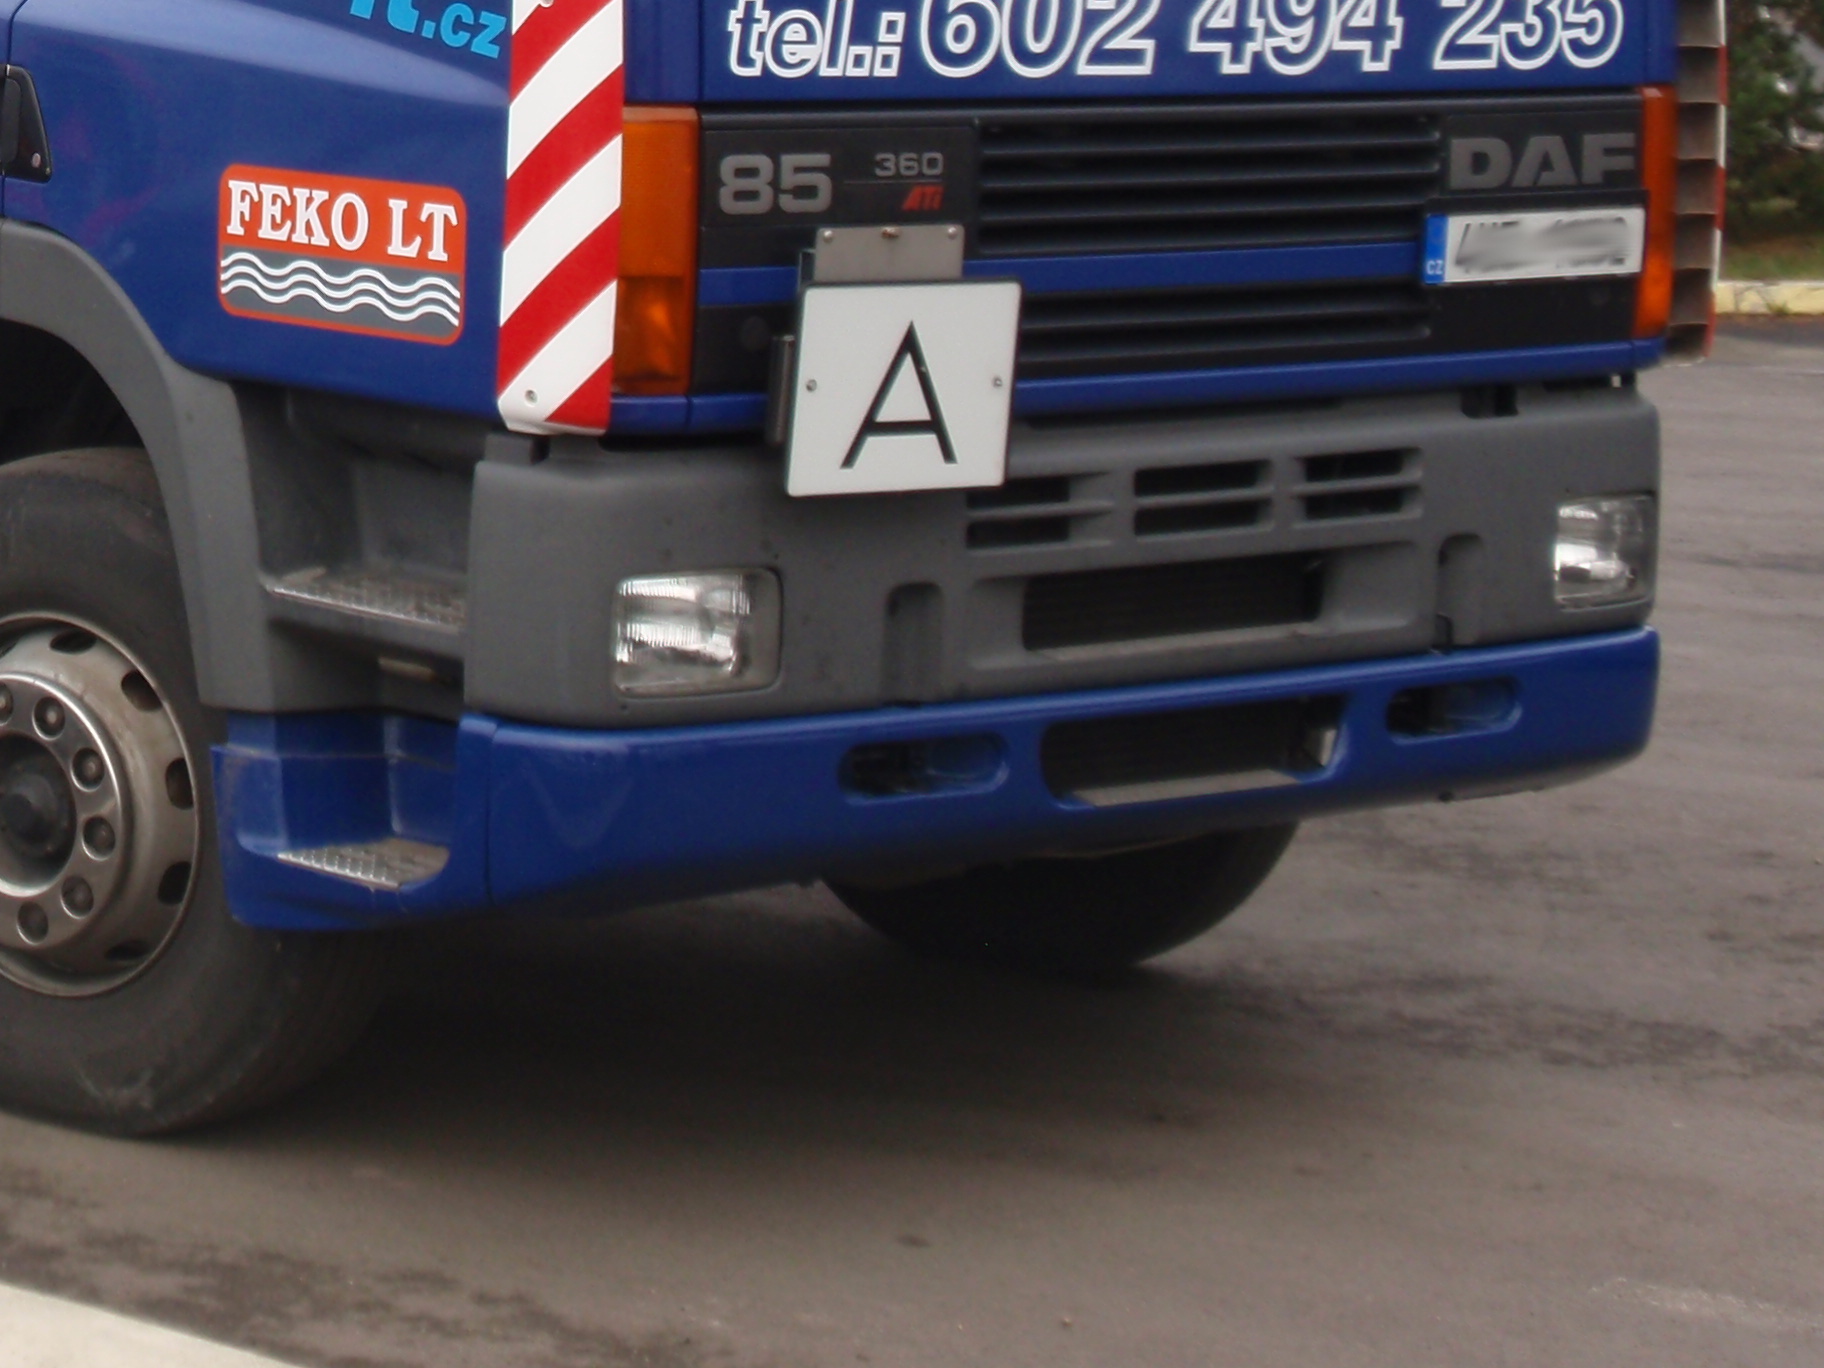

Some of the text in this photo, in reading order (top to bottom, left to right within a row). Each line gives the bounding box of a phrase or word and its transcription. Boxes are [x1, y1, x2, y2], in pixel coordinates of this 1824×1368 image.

[719, 152, 944, 215] 85 360
[1449, 133, 1636, 189] DAF
[227, 179, 459, 262] FEKO LT
[1426, 259, 1444, 275] CZ
[839, 319, 958, 470] A
